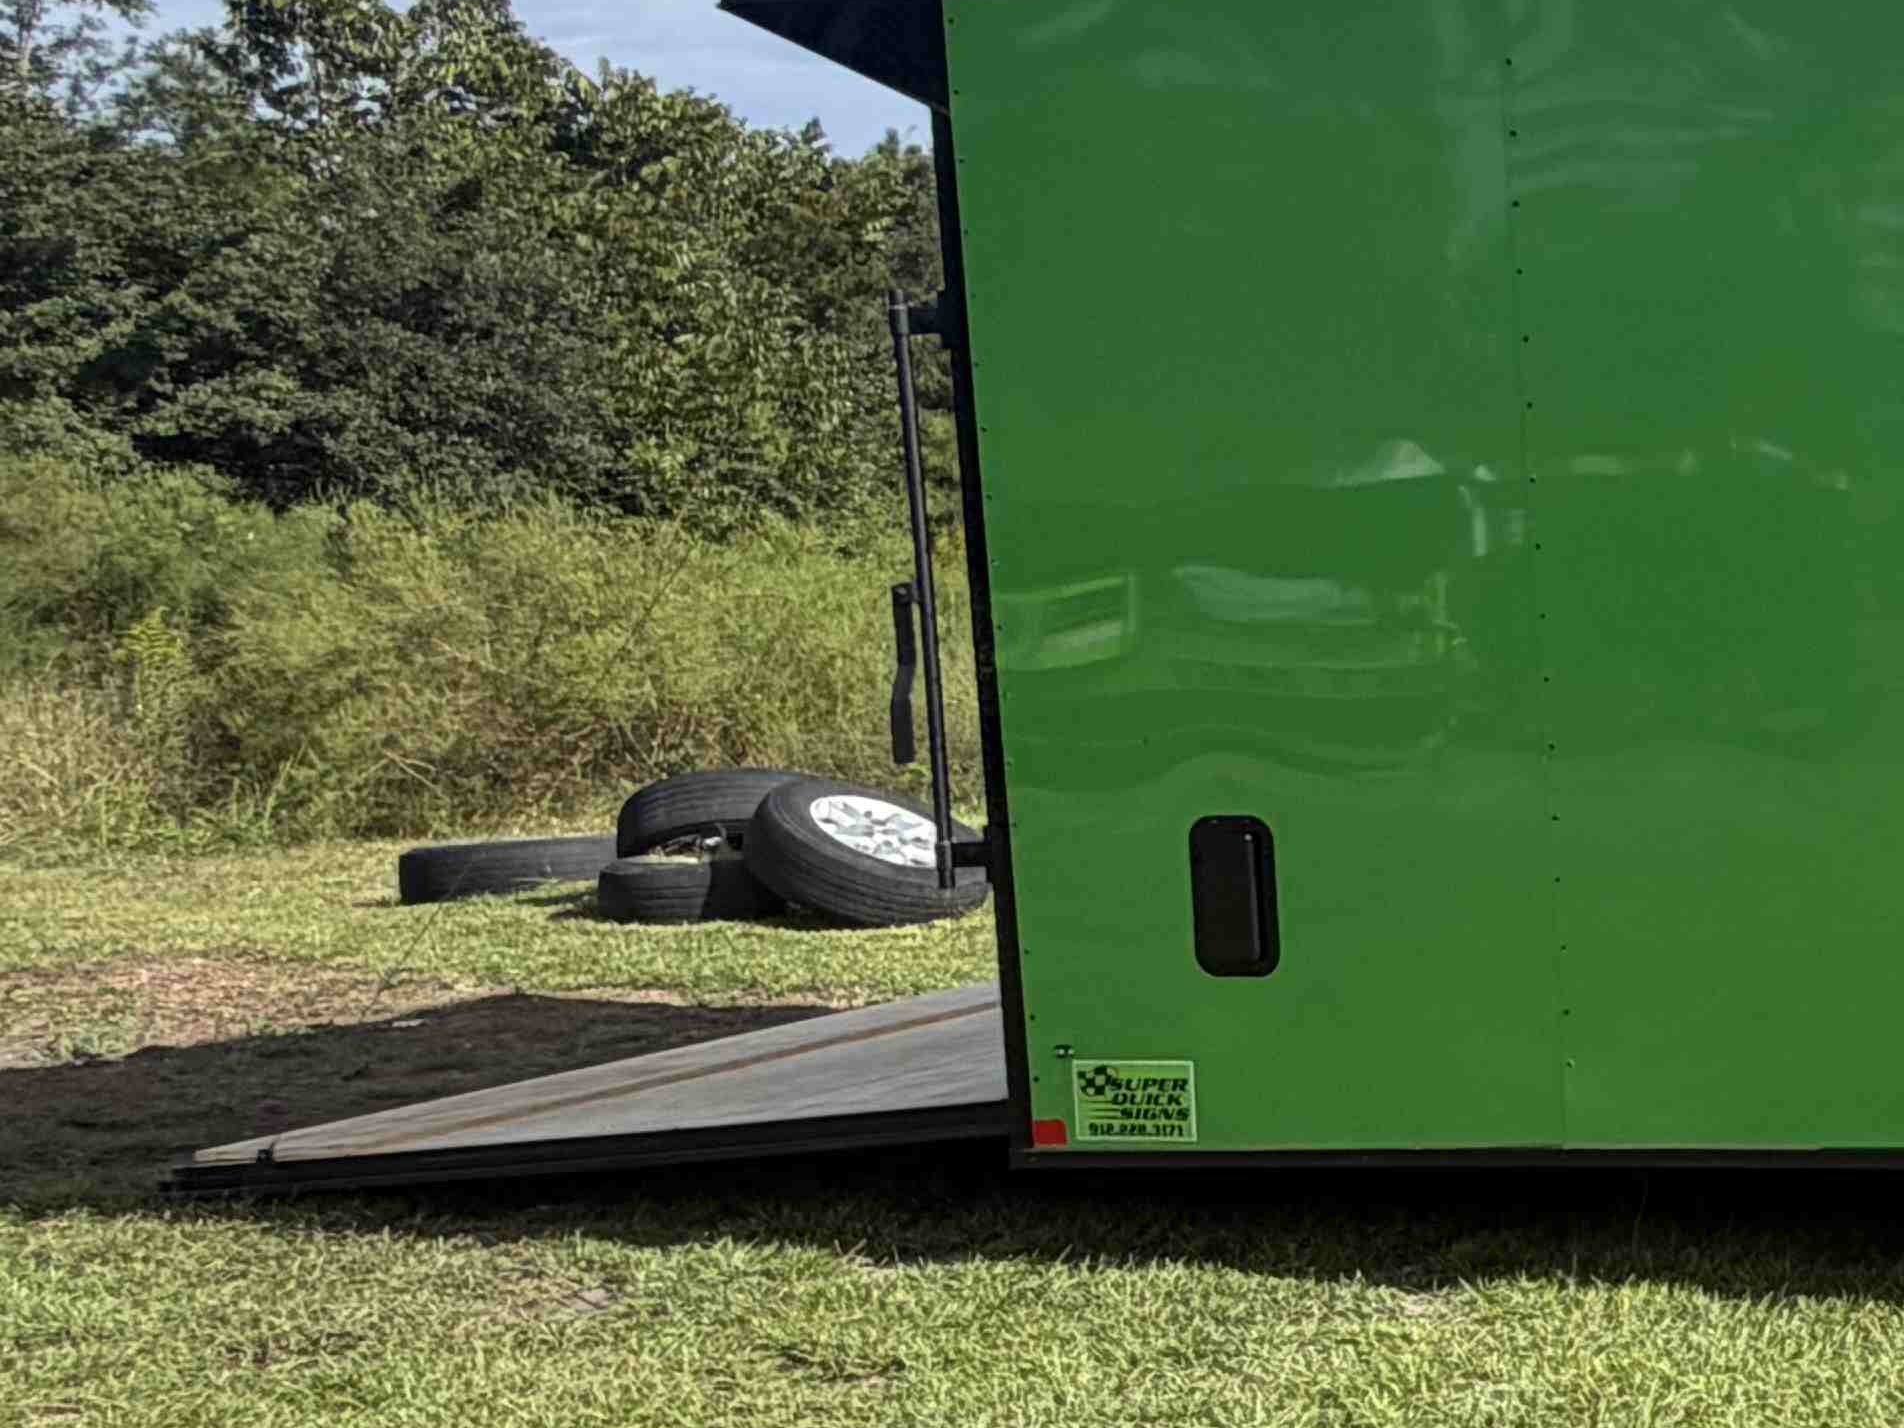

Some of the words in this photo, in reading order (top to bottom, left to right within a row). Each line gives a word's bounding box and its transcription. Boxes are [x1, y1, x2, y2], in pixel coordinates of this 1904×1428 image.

[1110, 1077, 1187, 1092] SUPER
[1112, 1093, 1183, 1106] QUICK
[1119, 1107, 1190, 1121] SIGNS
